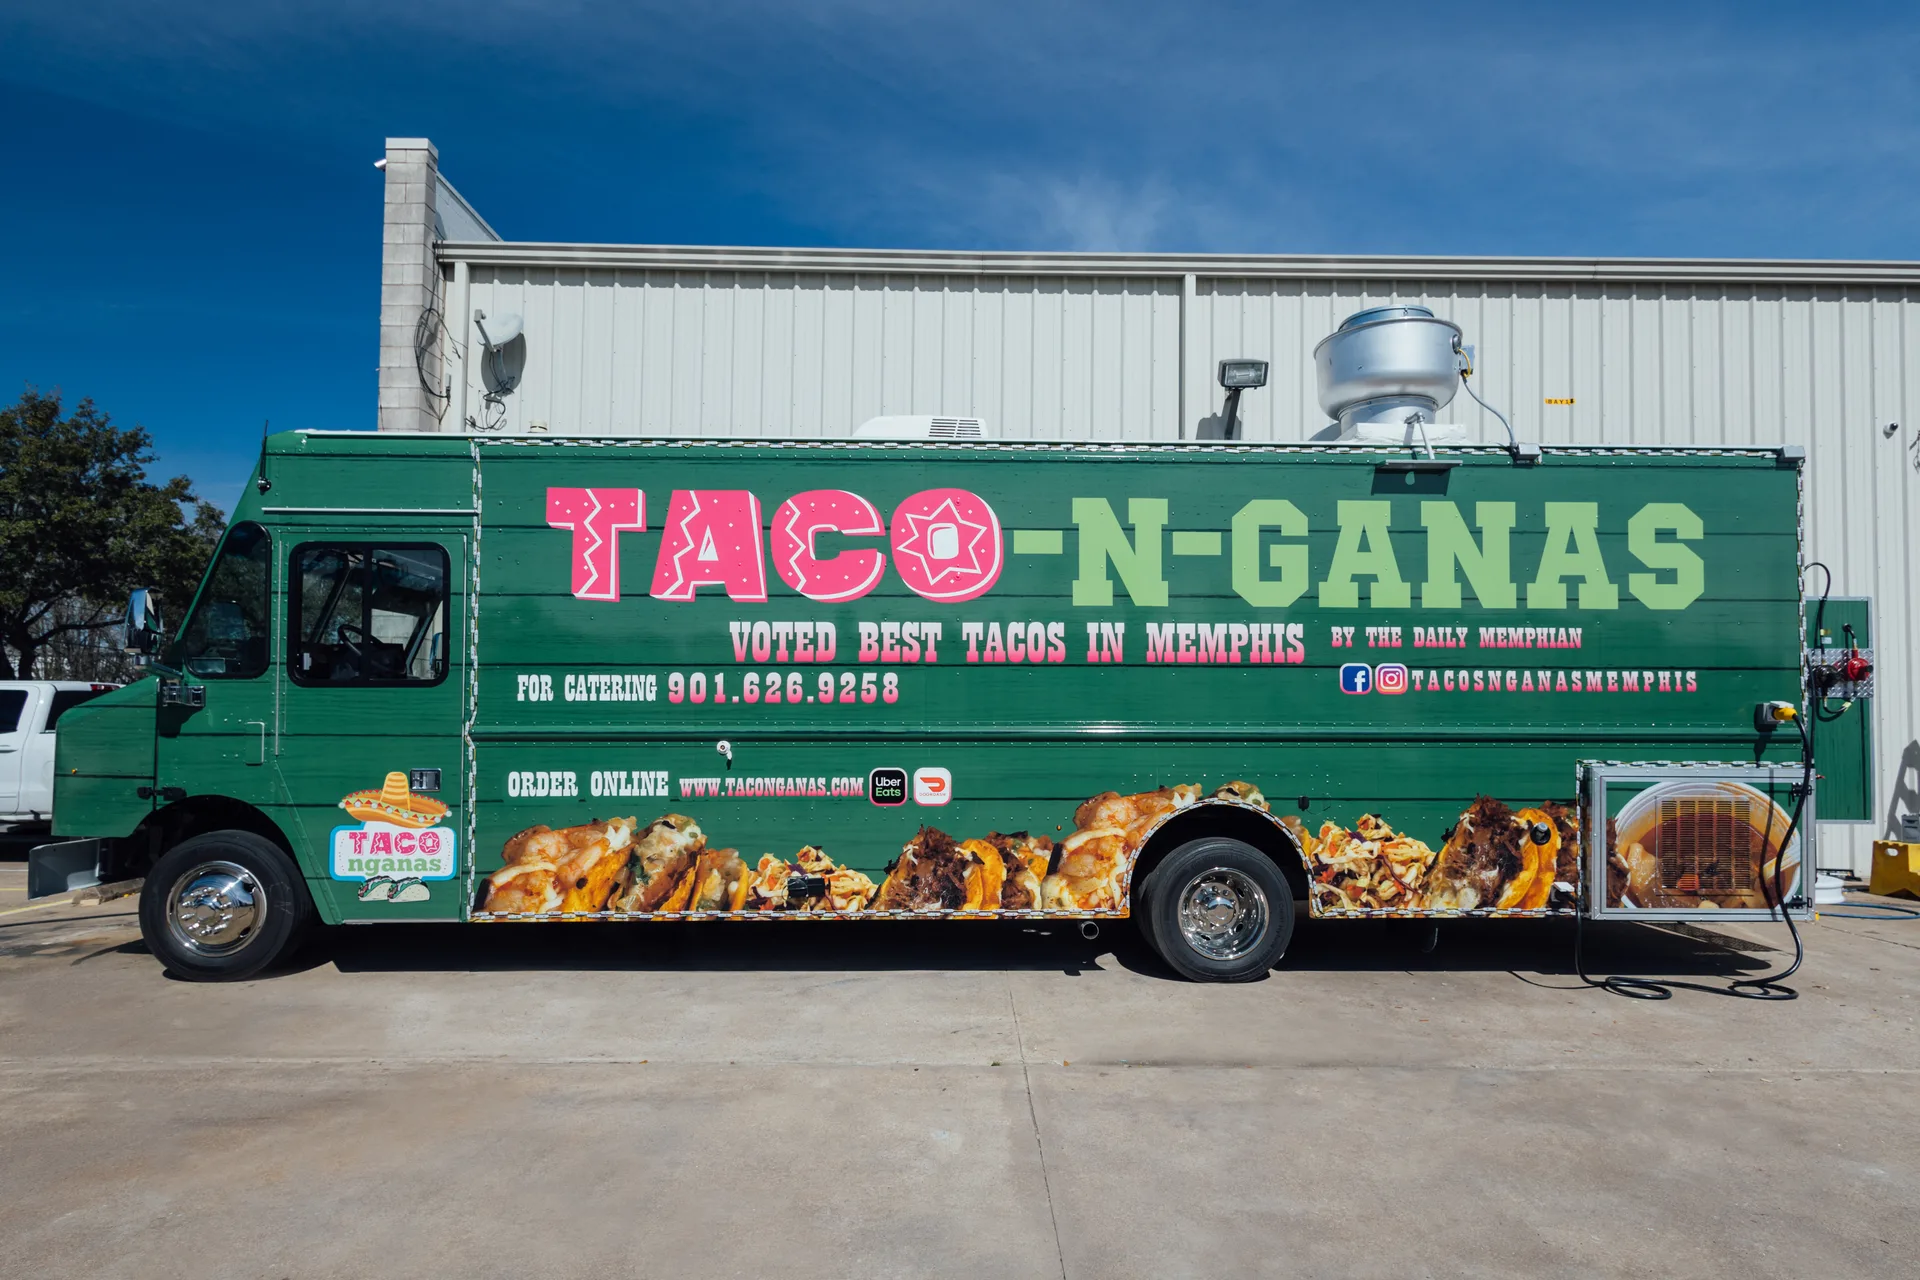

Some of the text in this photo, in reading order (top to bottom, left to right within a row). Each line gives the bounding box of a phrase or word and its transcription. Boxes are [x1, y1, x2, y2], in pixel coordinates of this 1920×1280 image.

[729, 620, 1305, 665] VOTED BEST TACOS IN MEMPHIS
[1331, 626, 1583, 649] BY THE DAILY MEMPHIAN
[517, 671, 899, 704] FOR CATERING 901.626.9258
[1411, 669, 1697, 693] TACOSNGANASMEMPHIS
[507, 769, 864, 798] ORDER ONLINE WWW.TACONGANAS.COM
[875, 777, 902, 787] Uber
[875, 787, 902, 797] Eats
[348, 831, 442, 856] TACO
[347, 857, 442, 877] nganas
